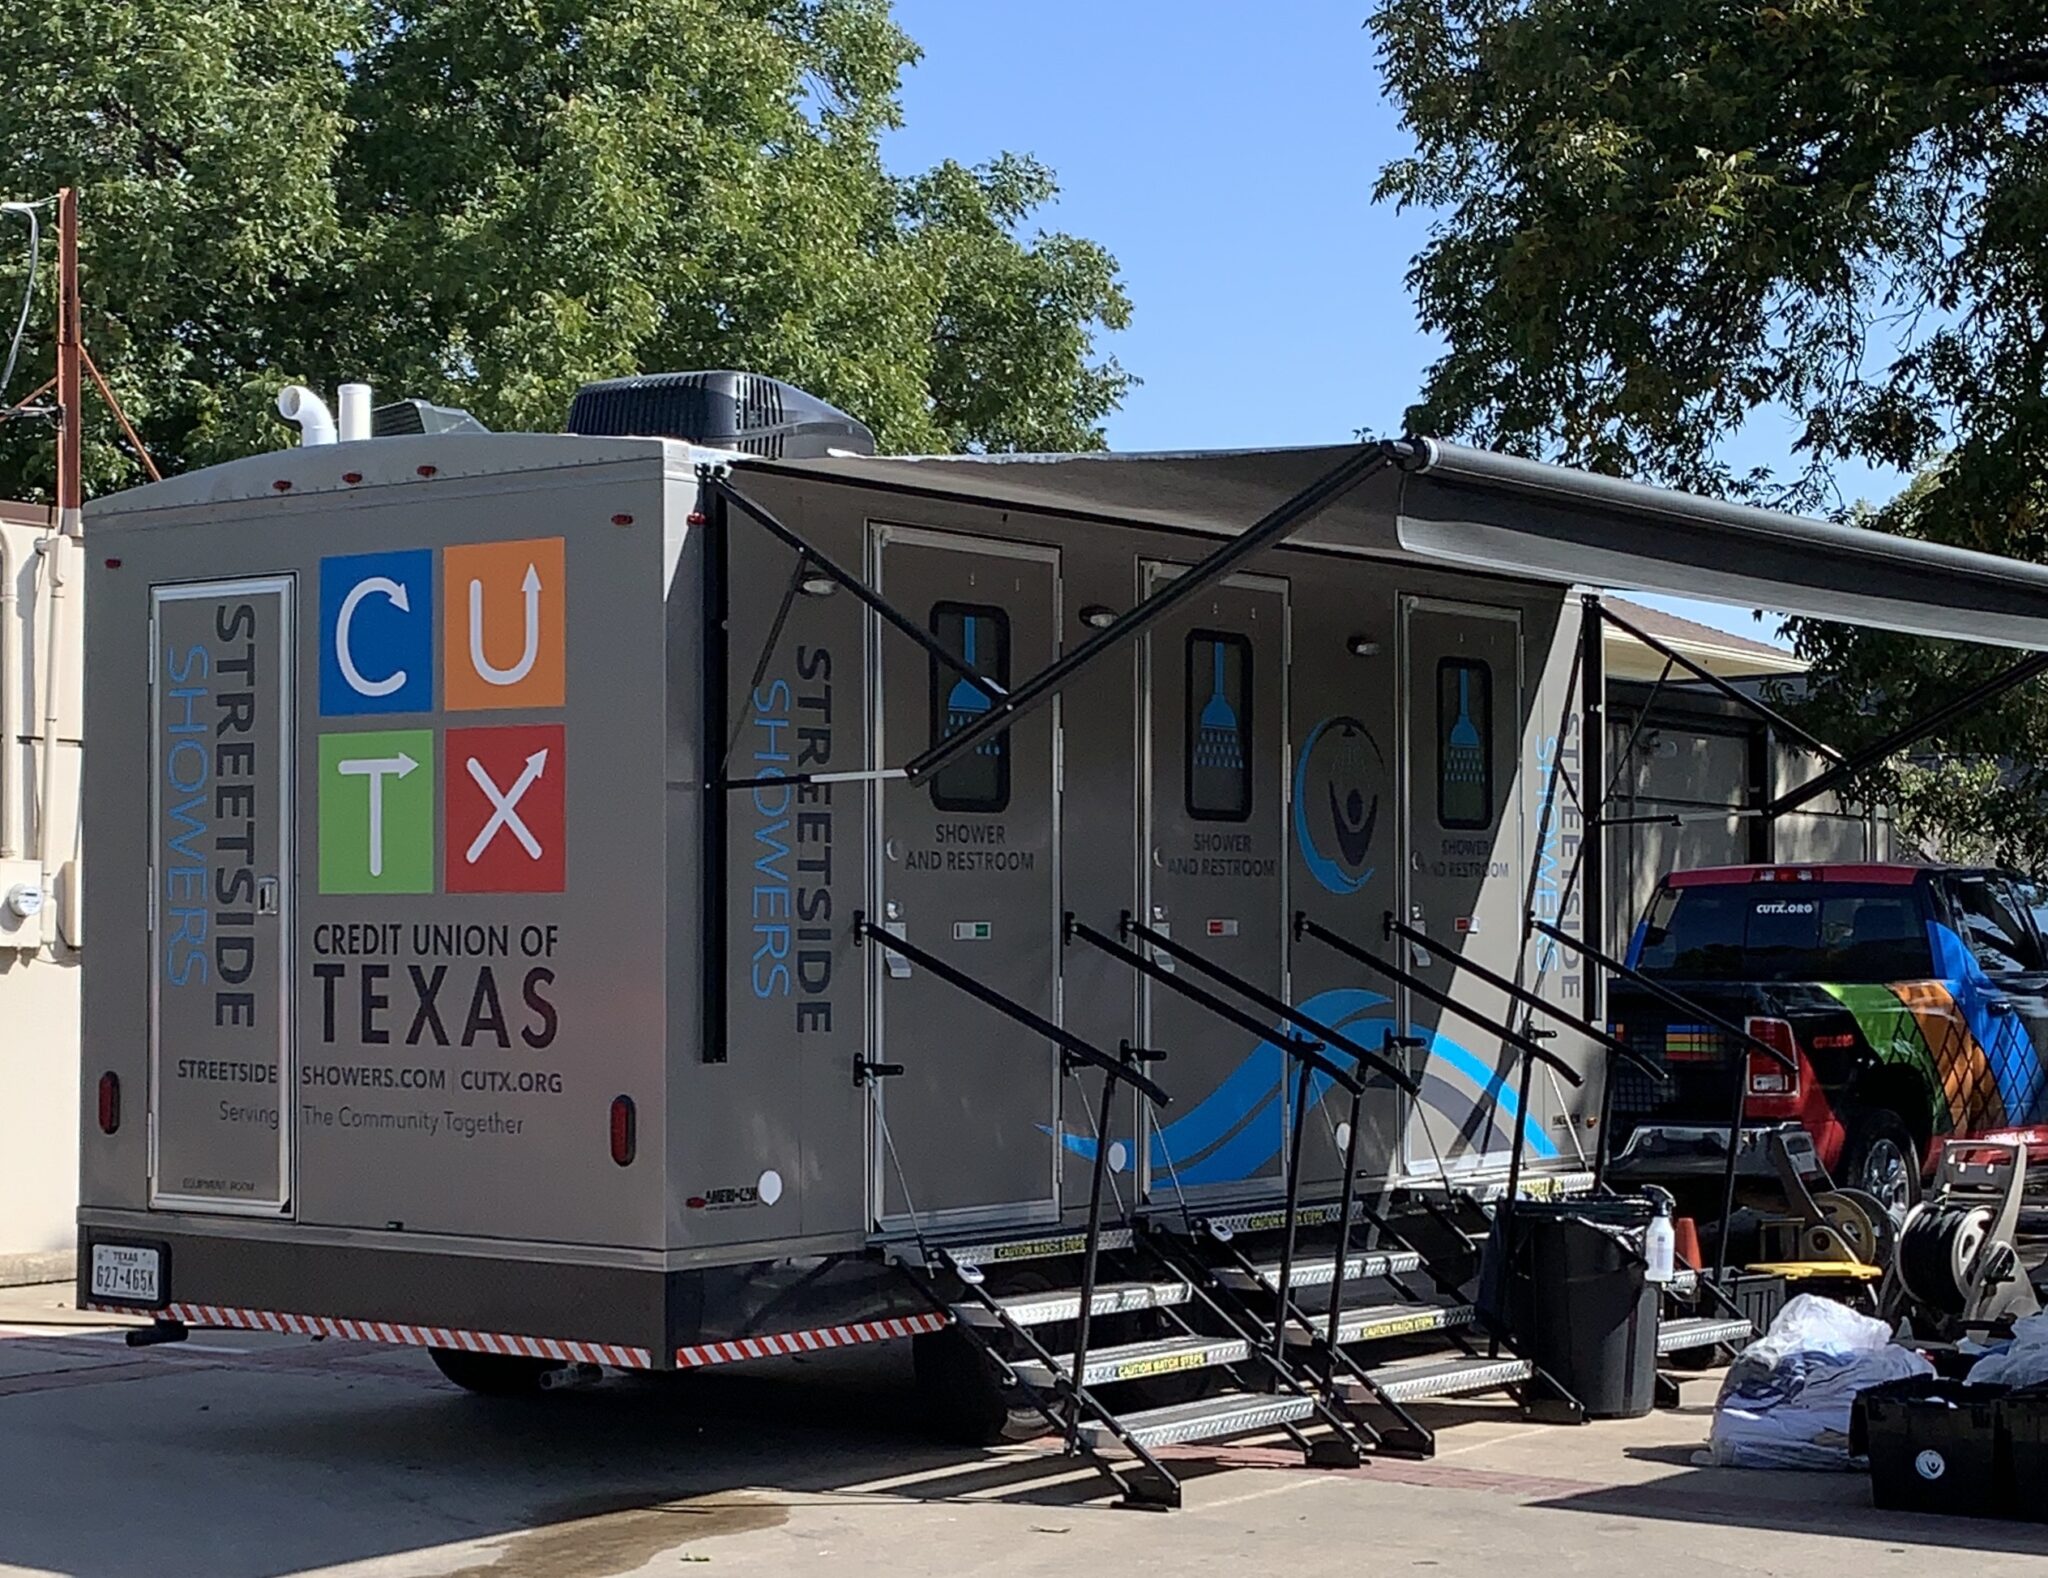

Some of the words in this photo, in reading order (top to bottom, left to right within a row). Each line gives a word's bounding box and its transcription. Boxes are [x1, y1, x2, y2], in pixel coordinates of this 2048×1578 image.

[167, 645, 208, 987] SHOWERS
[215, 603, 256, 1028] STREETSIDE
[753, 679, 790, 998] SHOWERS
[796, 645, 832, 1033] STREETSIDE
[935, 823, 1006, 844] SHOWER
[1193, 833, 1251, 852] SHOWER
[905, 850, 942, 870] AND
[946, 851, 1034, 871] RESTROOM
[1168, 858, 1198, 875] AND
[1201, 859, 1275, 877] RESTROOM
[1756, 904, 1813, 914] CUTX.ORG
[313, 924, 402, 955] CREDIT
[413, 924, 508, 956] UNION
[520, 924, 558, 957] OF
[313, 963, 558, 1049] TEXAS
[177, 1059, 277, 1084] STREETSIDE
[302, 1065, 446, 1090] SHOWERS.COM
[460, 1070, 563, 1093] CUTX.ORG
[219, 1100, 279, 1130] Serving
[302, 1105, 333, 1126] The
[338, 1106, 439, 1136] Community
[444, 1111, 523, 1139] Together
[113, 1251, 138, 1262] TEXAS
